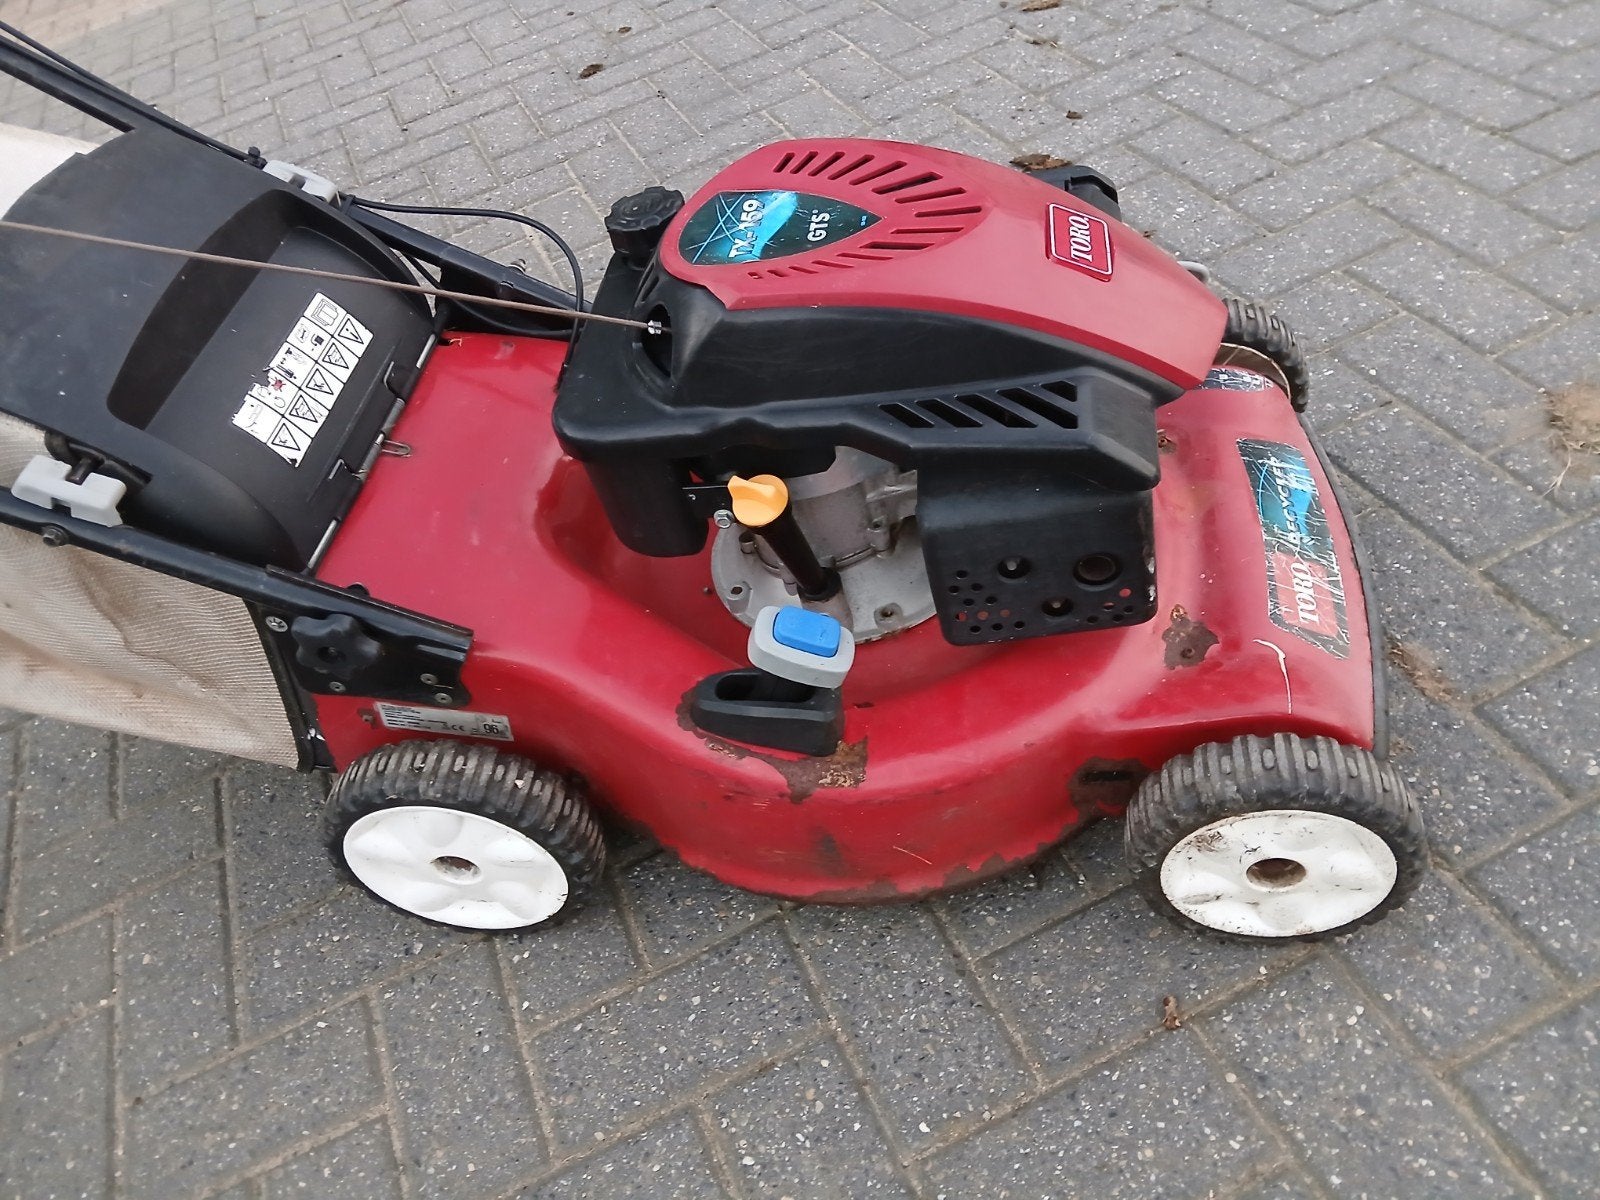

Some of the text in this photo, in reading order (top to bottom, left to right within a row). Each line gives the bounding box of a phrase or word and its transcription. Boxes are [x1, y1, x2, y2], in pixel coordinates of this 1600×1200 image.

[728, 199, 766, 258] TX-159
[1068, 215, 1093, 262] TORO
[1291, 562, 1319, 625] TORO
[483, 723, 499, 735] 96
